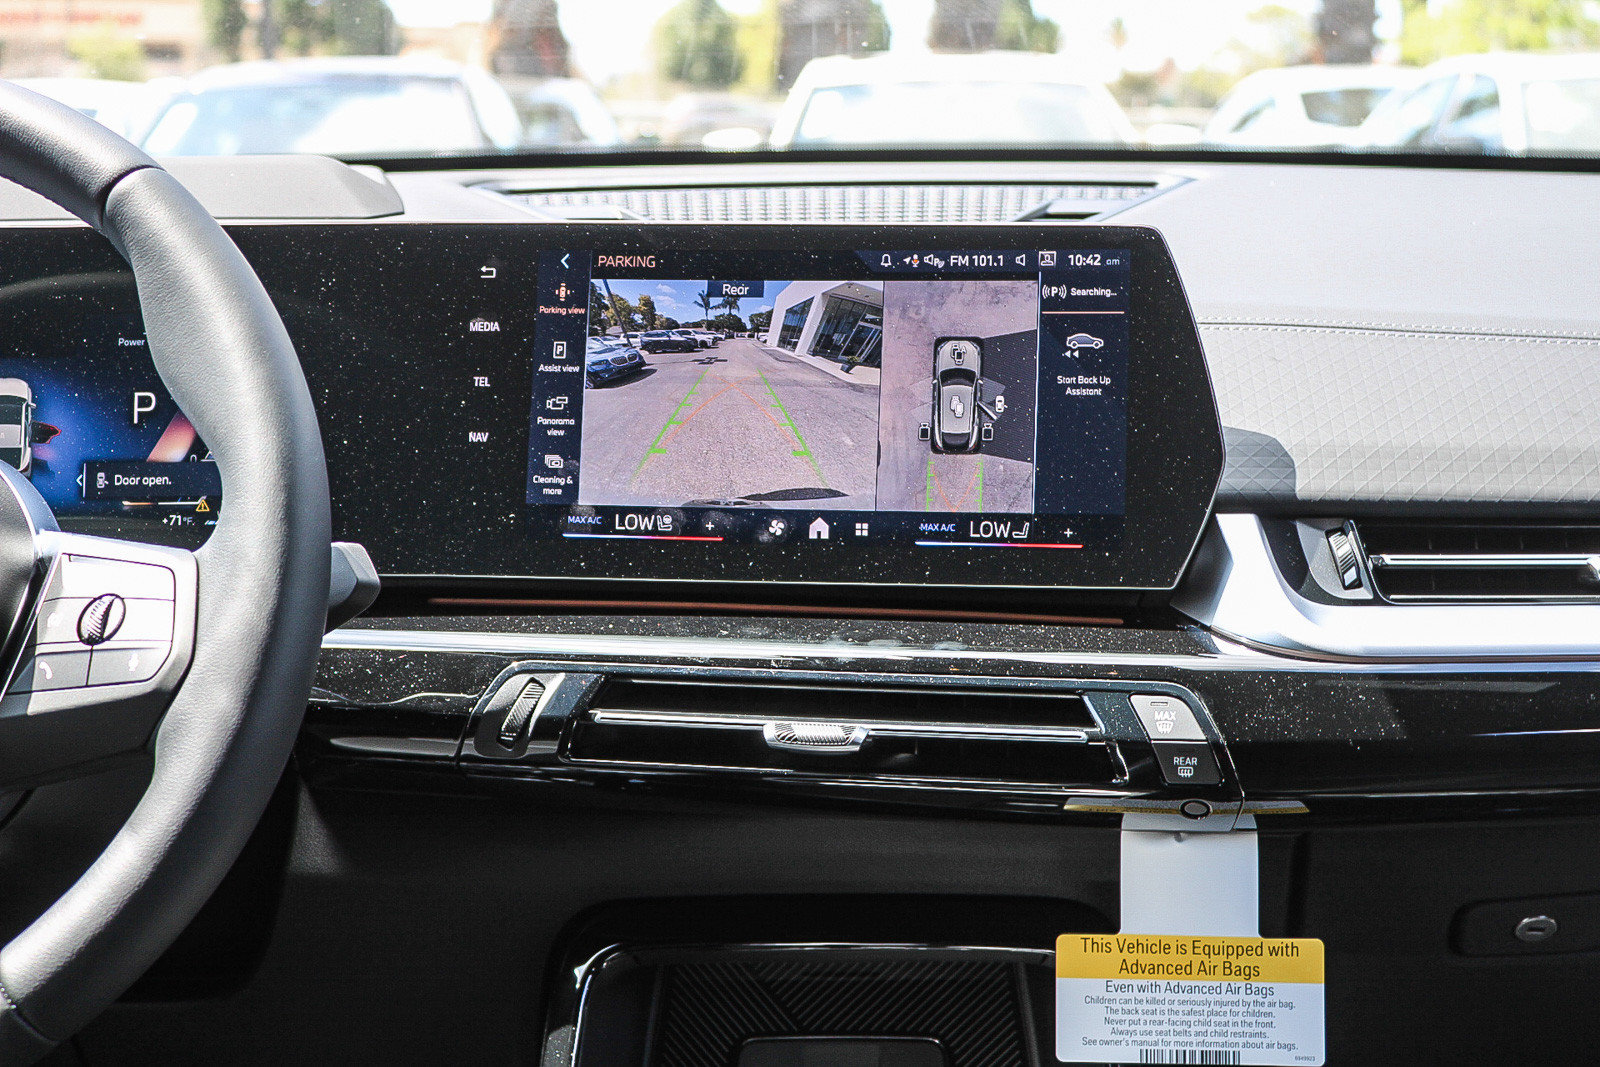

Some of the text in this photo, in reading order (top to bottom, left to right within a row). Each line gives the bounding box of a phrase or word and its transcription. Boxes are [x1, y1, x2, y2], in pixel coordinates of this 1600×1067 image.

[597, 255, 656, 268] PARKING
[950, 255, 1004, 266] FM 101.1
[1068, 254, 1101, 266] 10:42
[722, 284, 749, 295] Rear
[539, 306, 585, 315] Parking view
[469, 321, 501, 332] MEDIA
[118, 337, 146, 347] Power
[538, 364, 580, 373] Assist view
[473, 376, 491, 387] TEL
[1057, 376, 1111, 386] Start Back Up
[1065, 387, 1102, 396] Assistant
[133, 391, 156, 425] P
[537, 417, 575, 425] Panorama
[468, 431, 489, 442] NAV
[546, 427, 565, 436] view
[114, 474, 172, 488] Door open.
[532, 475, 573, 485] Cleaning &
[567, 515, 602, 525] MAX A/C
[615, 514, 655, 531] LOW
[920, 523, 956, 532] MAX A/C
[969, 521, 1010, 538] LOW
[1154, 711, 1176, 721] MAX
[1173, 756, 1198, 766] REAR
[1080, 937, 1299, 960] This Vehicle is Equipped with
[1119, 959, 1260, 980] Advanced Air Bags
[1105, 980, 1275, 998] Even with Advanced Air Bags
[1084, 995, 1117, 1005] Children
[1134, 996, 1144, 1005] be
[1145, 996, 1166, 1005] killed
[1177, 998, 1212, 1008] seriously
[1213, 998, 1240, 1008] injured
[1242, 998, 1251, 1009] by
[1252, 999, 1265, 1007] the
[1267, 999, 1277, 1007] air
[1278, 1000, 1296, 1010] bag.
[1104, 1006, 1276, 1018] The back seat is the safest place for children.
[1104, 1017, 1126, 1026] Never
[1128, 1018, 1141, 1027] put
[1149, 1018, 1191, 1029] rear-facing
[1193, 1018, 1211, 1027] child
[1213, 1020, 1230, 1028] seat
[1231, 1019, 1239, 1027] in
[1240, 1020, 1253, 1028] the
[1254, 1020, 1276, 1028] front.
[1110, 1027, 1137, 1037] Always
[1154, 1028, 1171, 1037] seat
[1172, 1028, 1192, 1037] belts
[1193, 1029, 1208, 1037] and
[1209, 1029, 1228, 1038] child
[1230, 1030, 1270, 1039] restraints.
[1081, 1036, 1097, 1046] See
[1098, 1038, 1129, 1046] owner's
[1131, 1038, 1160, 1047] manual
[1161, 1038, 1171, 1047] for
[1195, 1039, 1240, 1048] information
[1241, 1040, 1264, 1049] about
[1265, 1041, 1275, 1049] air
[1276, 1042, 1299, 1052] bags.
